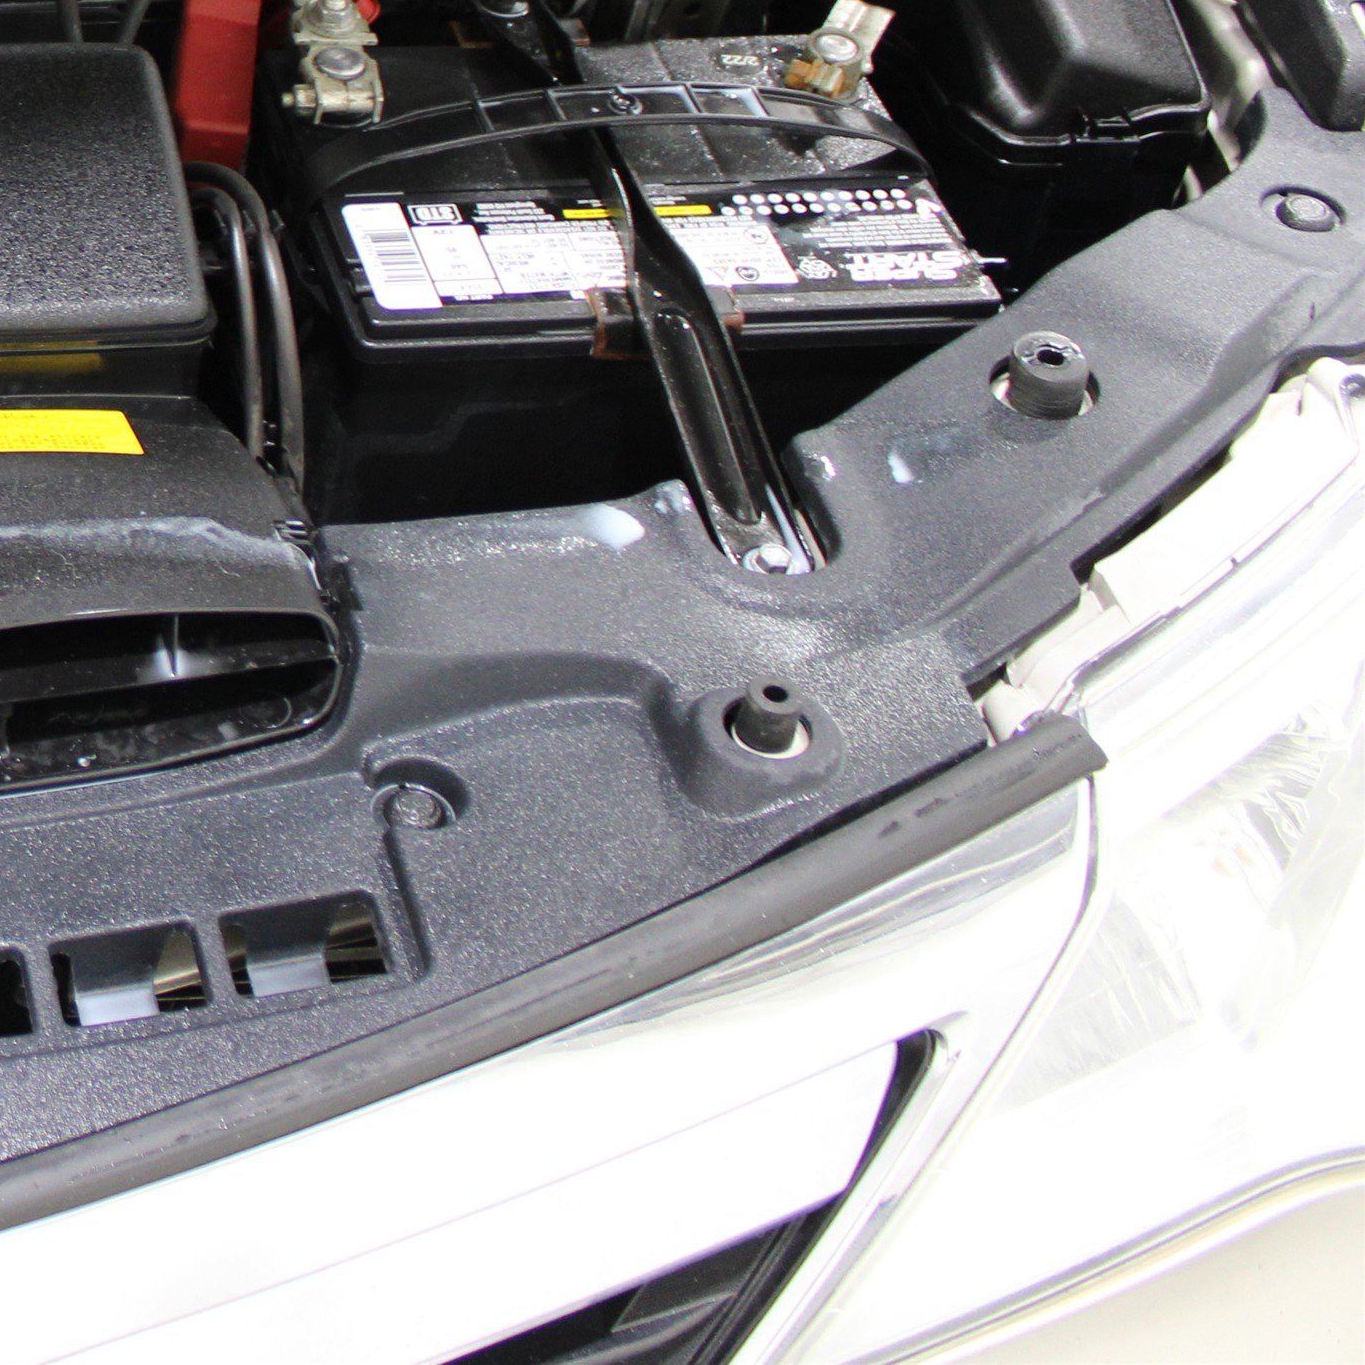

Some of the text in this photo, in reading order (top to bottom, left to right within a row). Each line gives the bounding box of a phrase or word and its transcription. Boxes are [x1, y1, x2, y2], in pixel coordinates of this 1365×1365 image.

[417, 205, 456, 223] STD
[847, 251, 963, 268] START
[850, 266, 959, 283] SUPER
